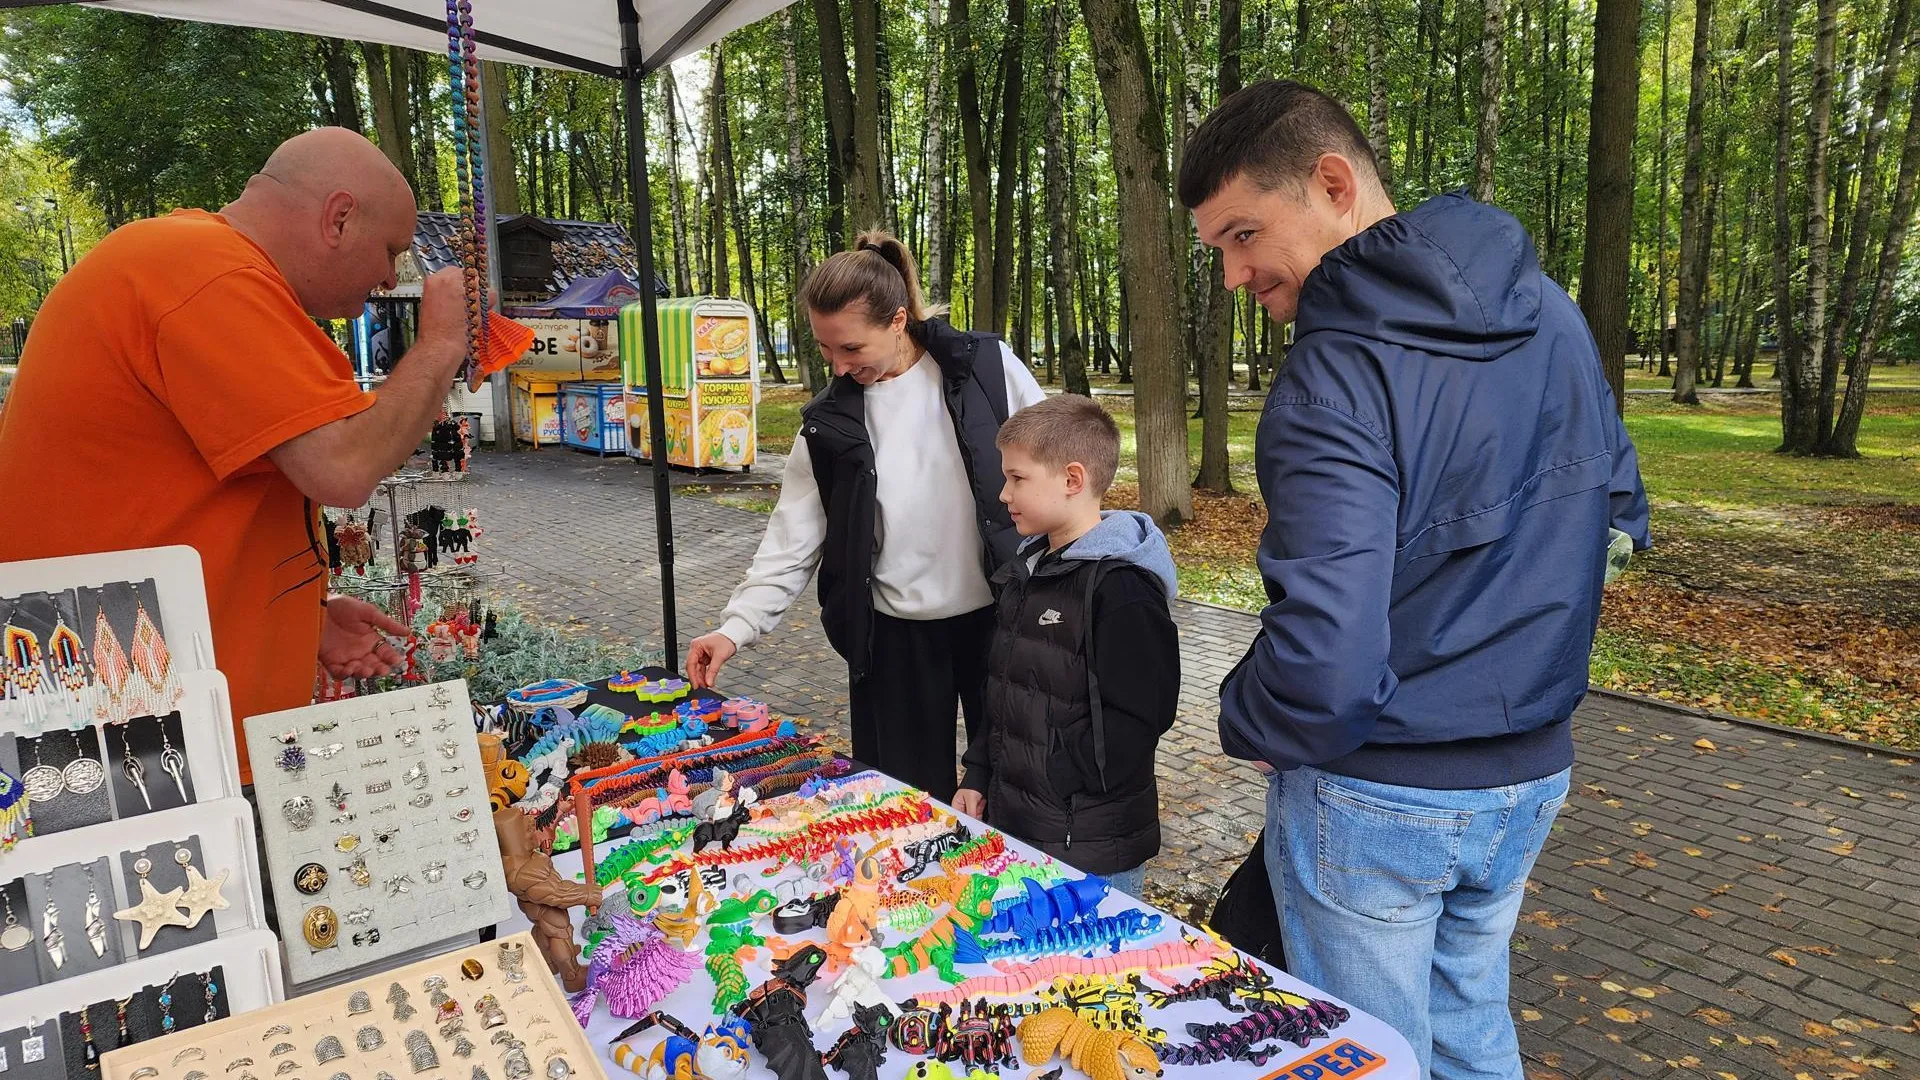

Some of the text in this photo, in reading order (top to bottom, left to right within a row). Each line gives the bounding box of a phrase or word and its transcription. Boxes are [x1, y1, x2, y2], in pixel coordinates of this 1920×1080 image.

[697, 317, 717, 336] КВАС
[528, 337, 558, 355] ФЕ
[703, 383, 746, 393] ГОРЯЧАЯ
[701, 395, 750, 405] КУКУРУЗА
